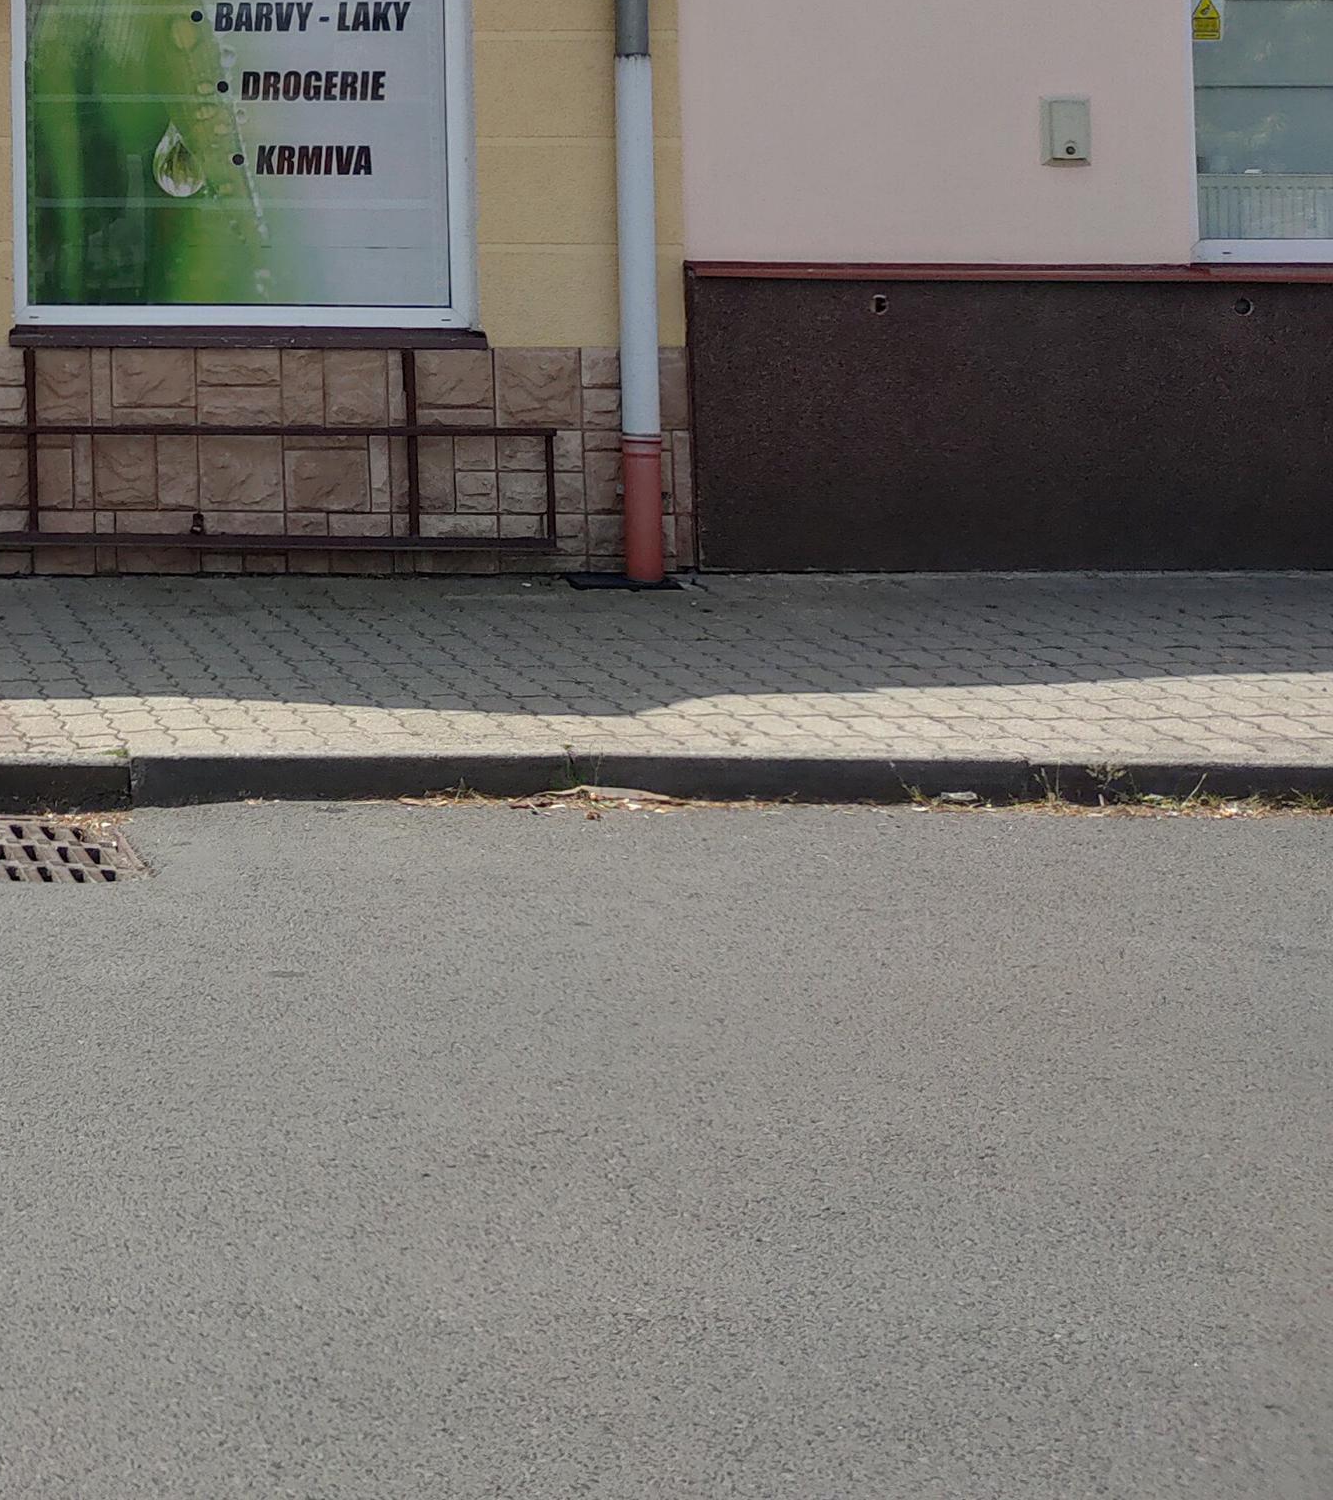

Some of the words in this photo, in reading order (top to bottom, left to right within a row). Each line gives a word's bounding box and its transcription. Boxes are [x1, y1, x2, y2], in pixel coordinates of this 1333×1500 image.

[214, 2, 313, 32] BARVY
[337, 1, 411, 32] LAKY
[241, 71, 386, 101] DROGERIE
[256, 146, 373, 175] KRMIVA
